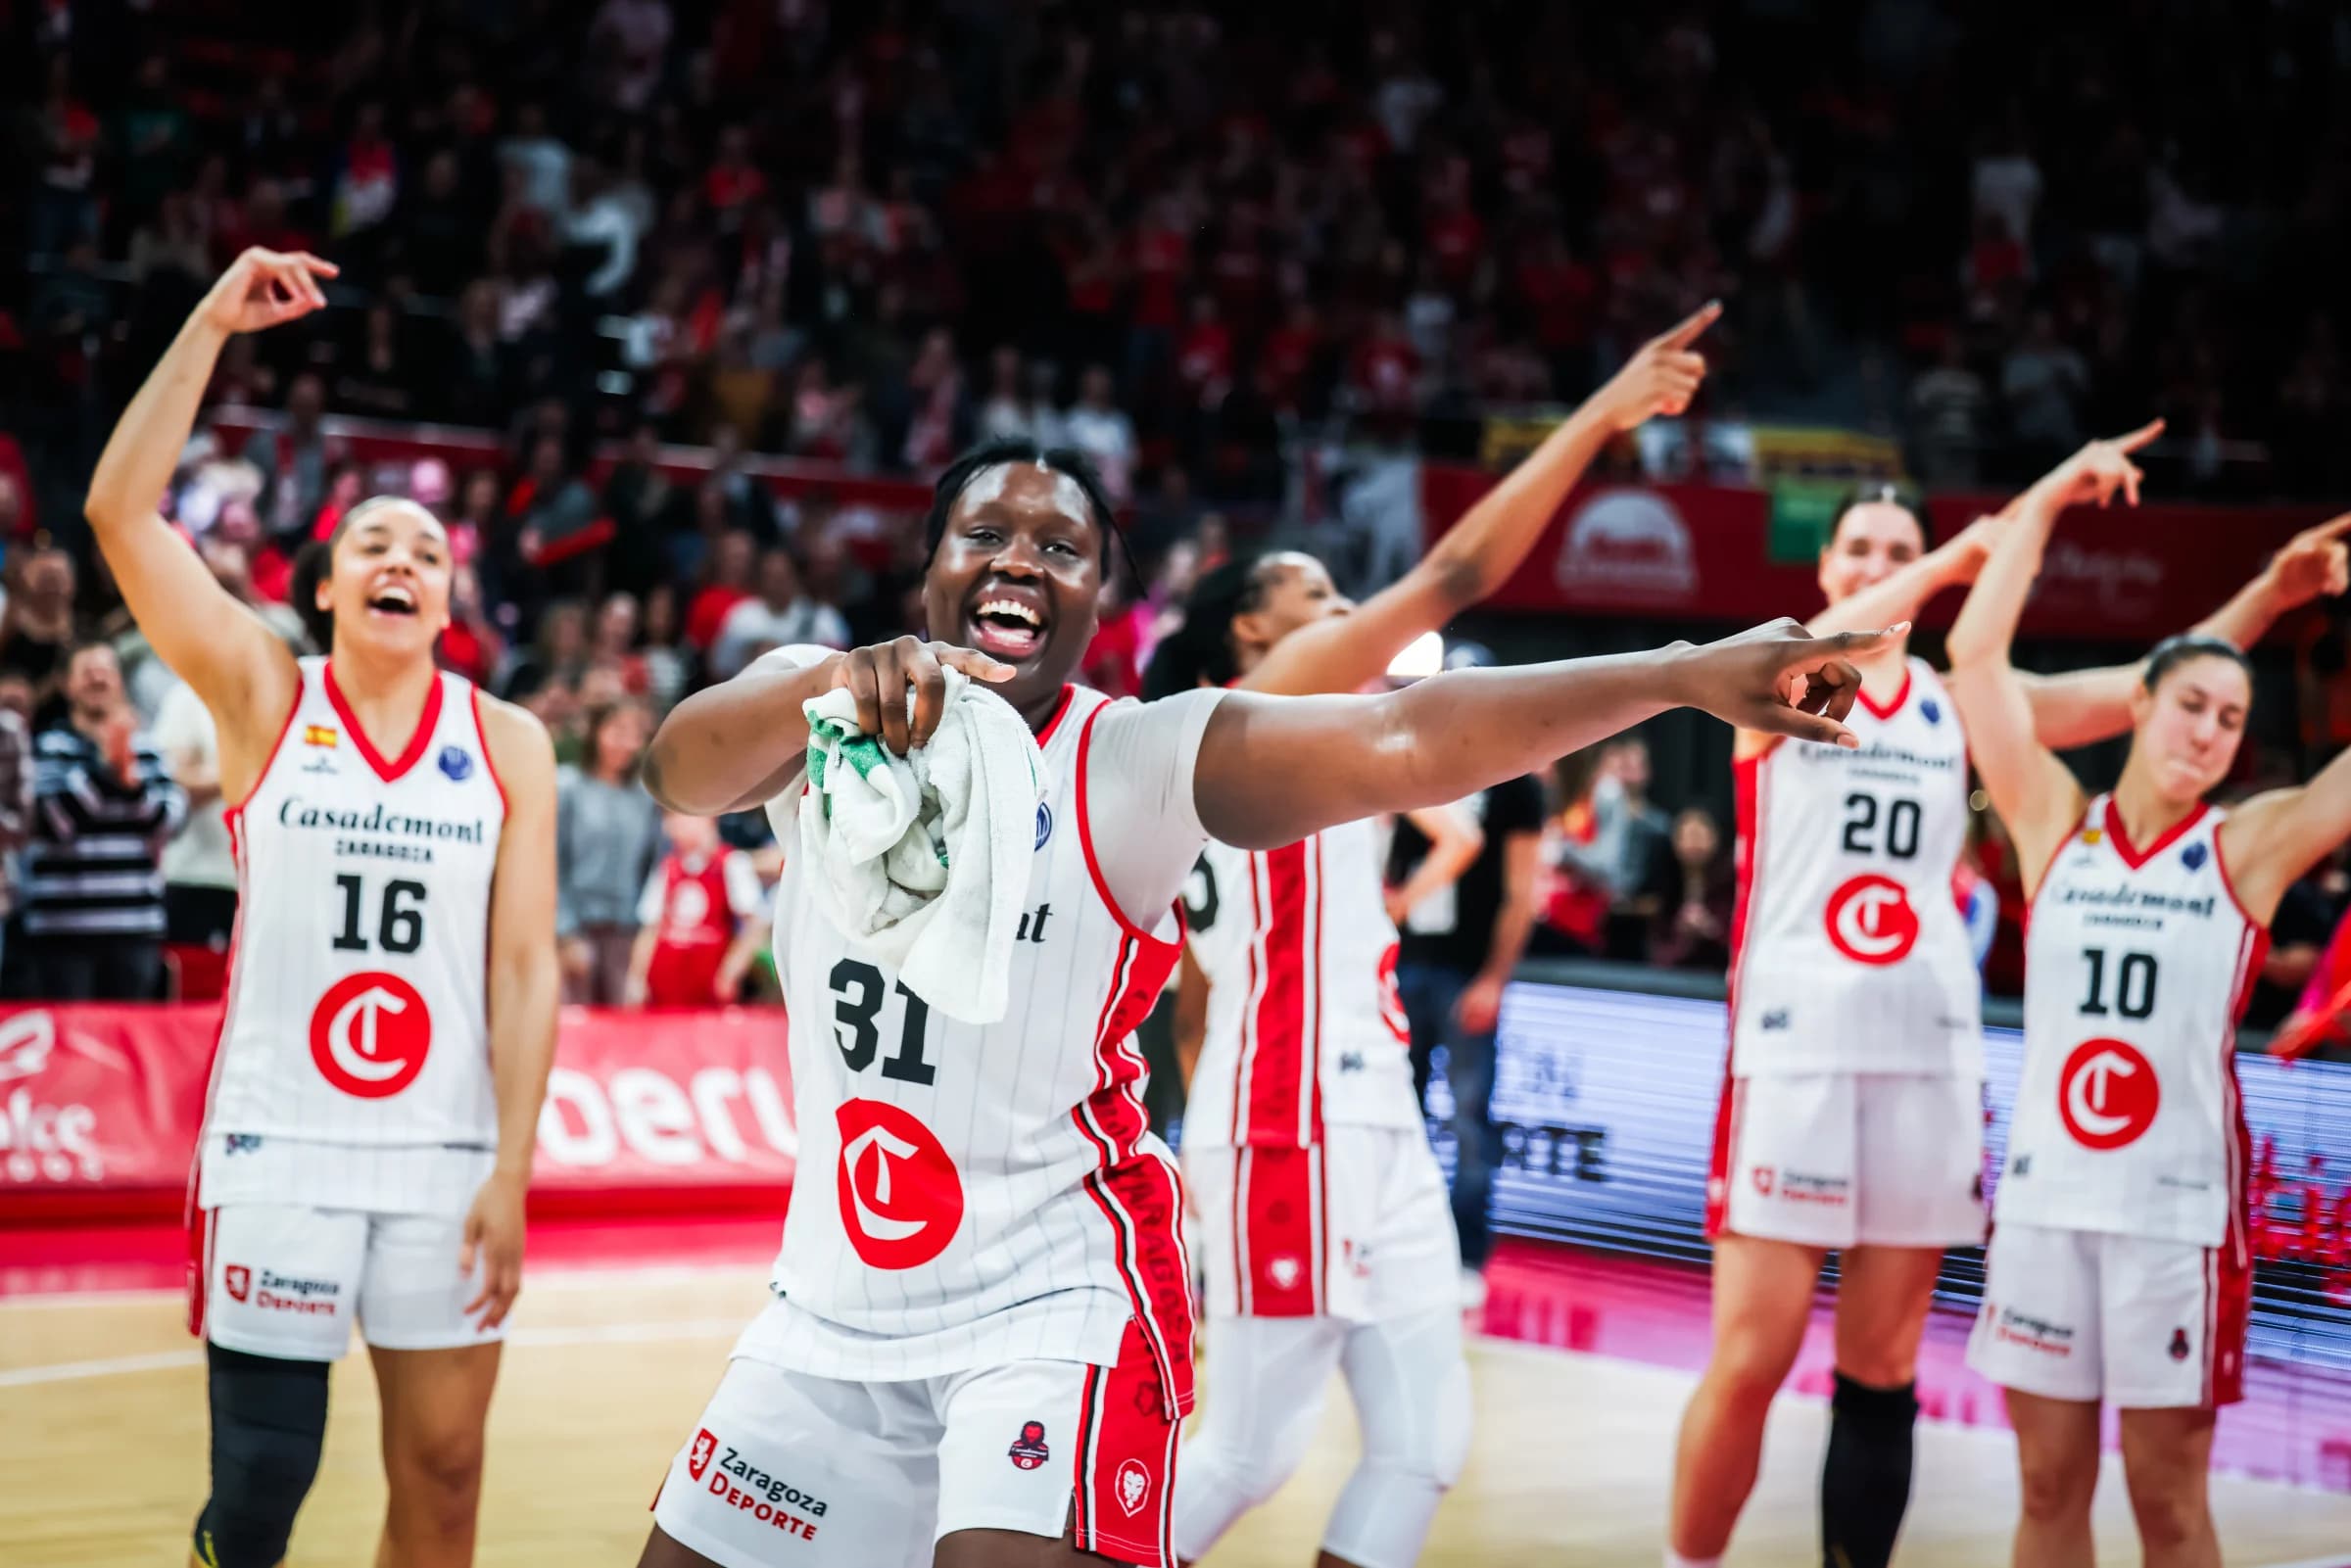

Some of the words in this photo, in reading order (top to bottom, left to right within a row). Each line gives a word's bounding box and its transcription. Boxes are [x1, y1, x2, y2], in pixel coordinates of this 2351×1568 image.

[279, 796, 484, 844] Casademont
[1842, 791, 1921, 860] 20
[333, 874, 427, 954] 16
[2079, 947, 2158, 1020] 10
[829, 957, 936, 1087] 31
[708, 1471, 817, 1542] DEPORTE
[719, 1446, 828, 1518] Zaragoza
